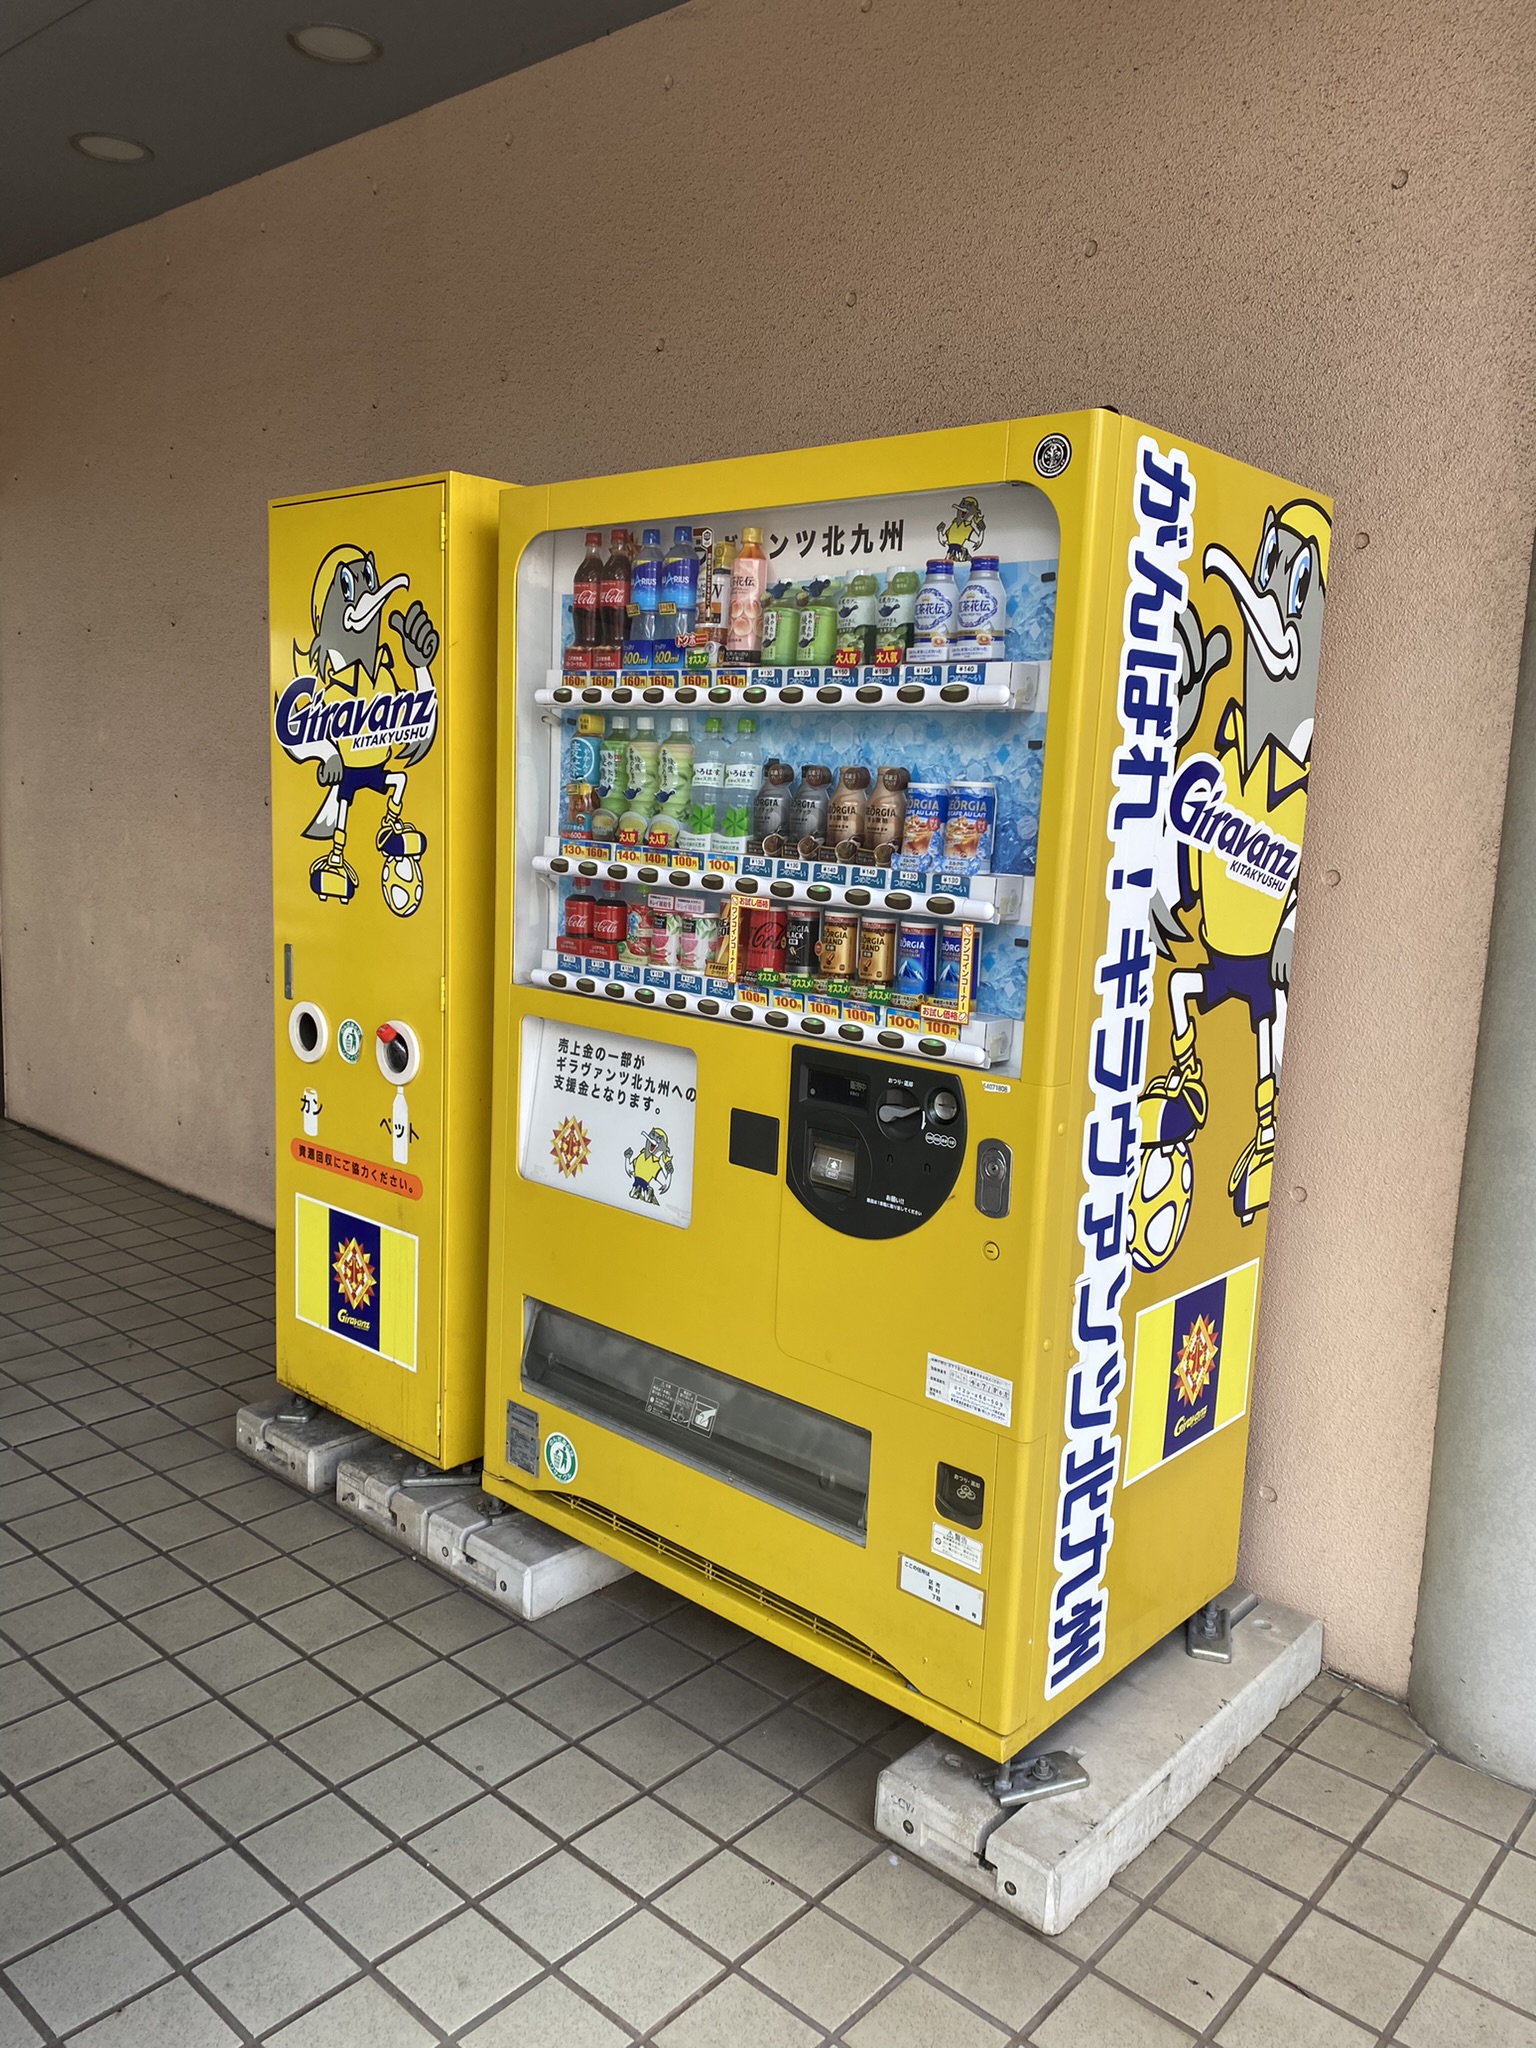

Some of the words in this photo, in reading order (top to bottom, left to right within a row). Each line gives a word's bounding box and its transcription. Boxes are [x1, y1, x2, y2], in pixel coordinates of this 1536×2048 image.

[623, 652, 648, 665] 600ml
[654, 651, 679, 664] 600ml
[836, 653, 857, 664] 大人気
[876, 651, 898, 663] 大人気
[564, 676, 585, 687] 160円
[591, 676, 613, 687] 160円
[623, 675, 645, 687] 160円
[649, 675, 673, 687] 160円
[683, 675, 707, 687] 160円
[718, 675, 743, 687] 150円
[276, 677, 435, 746] Giravanz
[352, 726, 429, 749] KITAKYUSHU
[1170, 760, 1298, 881] Giravanz
[619, 832, 636, 843] 大人気
[649, 835, 666, 845] 大人気
[1230, 860, 1286, 892] KITAKYUSHU
[739, 897, 769, 908] お試し価格
[730, 907, 738, 971] ワンコインコーナー
[960, 937, 971, 1010] ワンコインコーナー
[740, 991, 766, 1004] 100円
[775, 996, 801, 1010] 100円
[810, 1002, 837, 1016] 100円
[846, 1008, 874, 1022] 100円
[922, 1006, 958, 1019] お試し価格
[889, 1015, 919, 1030] 100円
[926, 1020, 958, 1036] 100円
[557, 1038, 645, 1070] 売上金の一部が
[556, 1057, 697, 1102] ギラヴァンツ北九州への
[553, 1075, 661, 1115] 支援金となります。
[300, 1095, 323, 1115] カン
[380, 1117, 420, 1143] ペット
[298, 1144, 413, 1193] 資源回収にご協力ください。
[337, 1308, 371, 1329] Giravanz
